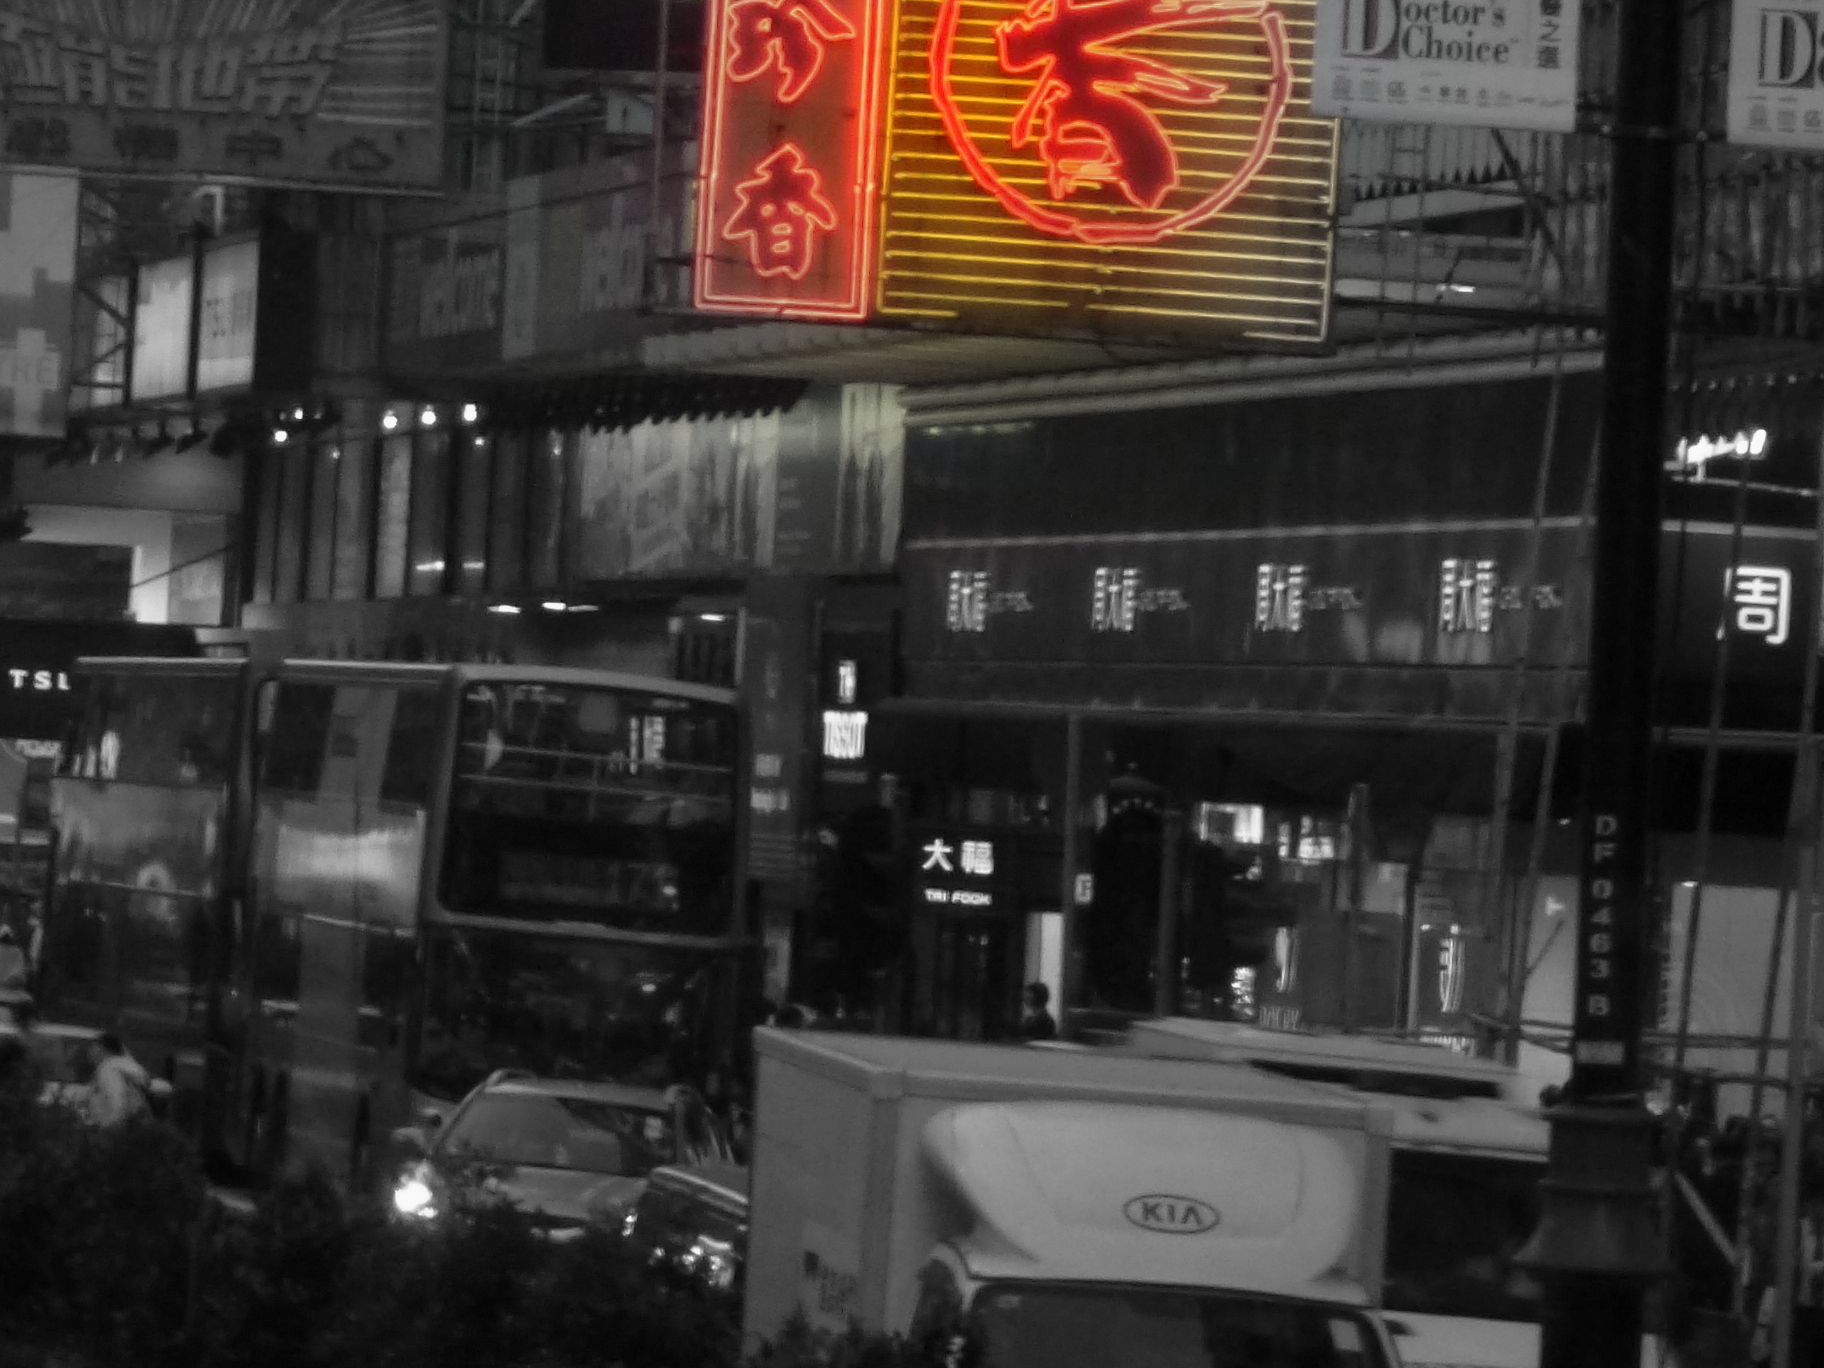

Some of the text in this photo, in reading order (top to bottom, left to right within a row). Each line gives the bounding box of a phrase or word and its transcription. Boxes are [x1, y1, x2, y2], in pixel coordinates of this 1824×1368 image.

[1401, 23, 1510, 65] Choice
[8, 668, 72, 692] TSL
[922, 838, 995, 875] 大福
[1141, 1201, 1203, 1227] KIA
